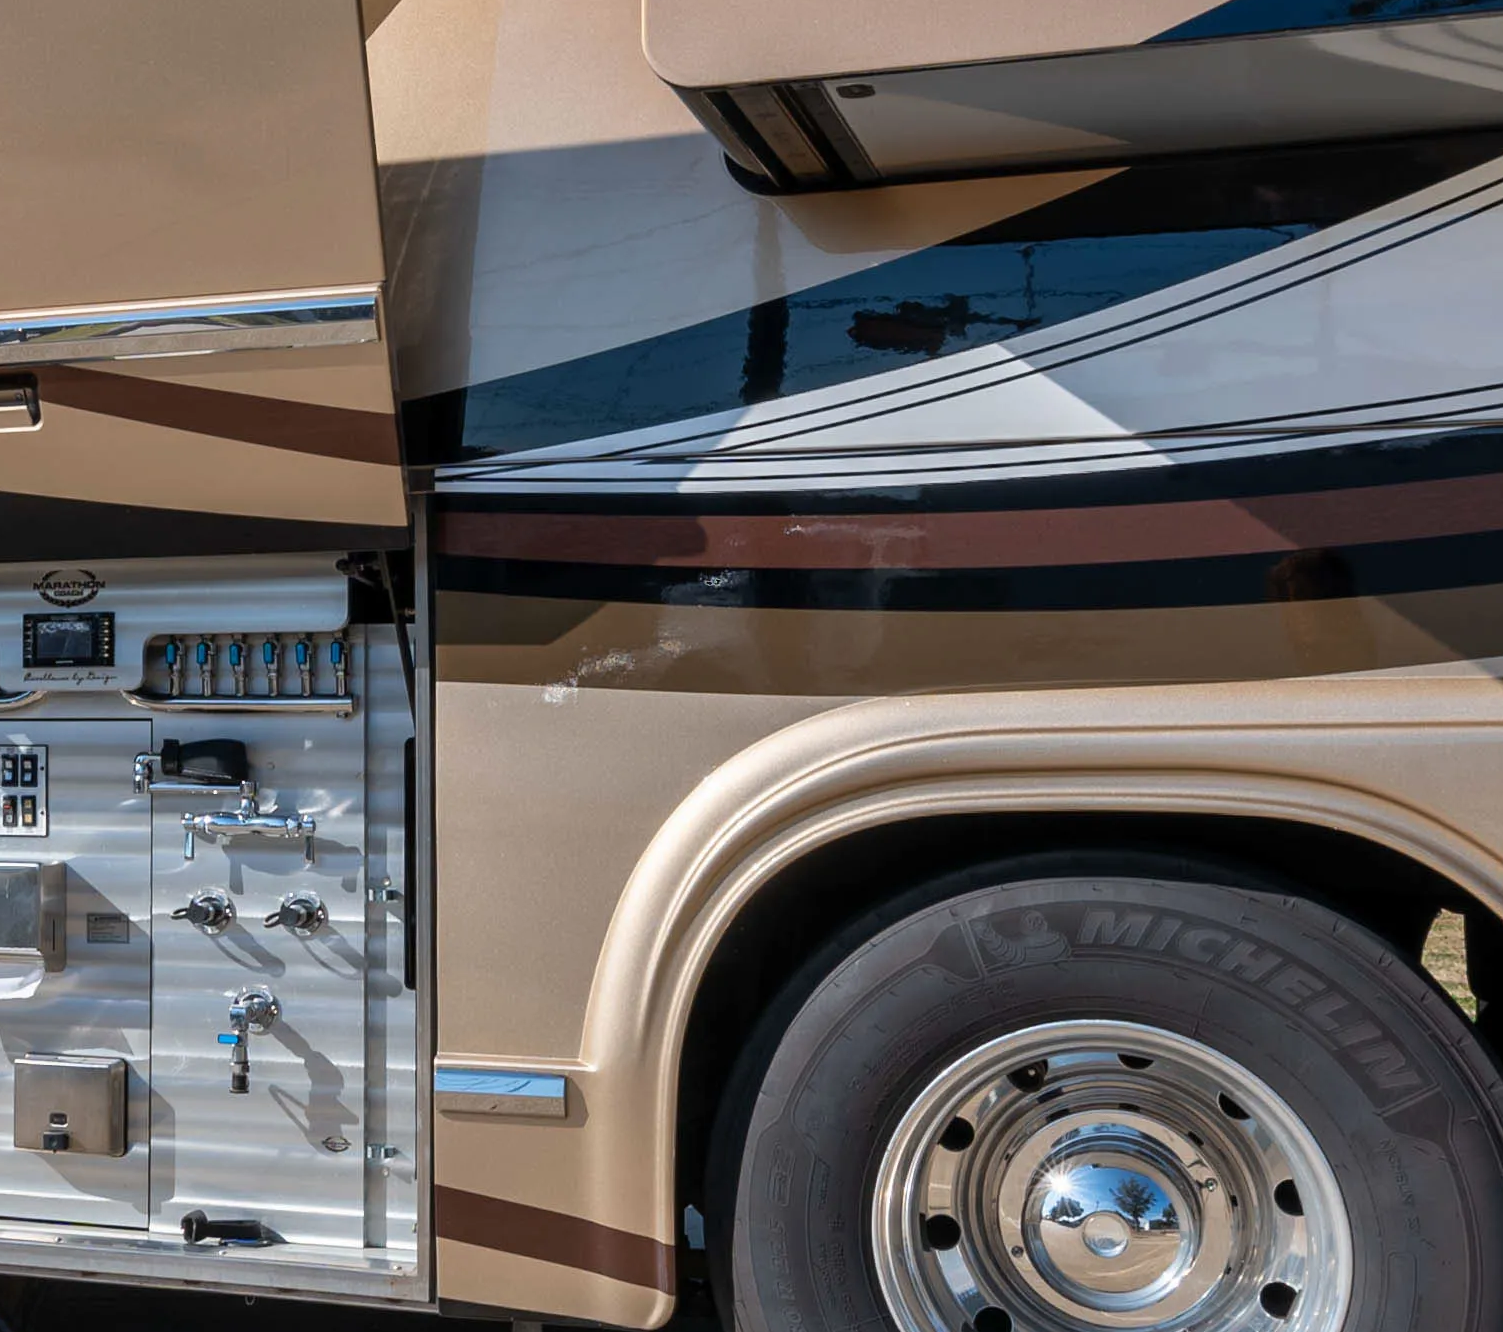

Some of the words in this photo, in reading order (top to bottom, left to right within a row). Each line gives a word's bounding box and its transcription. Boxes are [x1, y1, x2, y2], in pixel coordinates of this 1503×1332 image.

[33, 579, 106, 590] MARATHON
[53, 589, 84, 597] COACH
[1075, 907, 1422, 1090] MICHELIN
